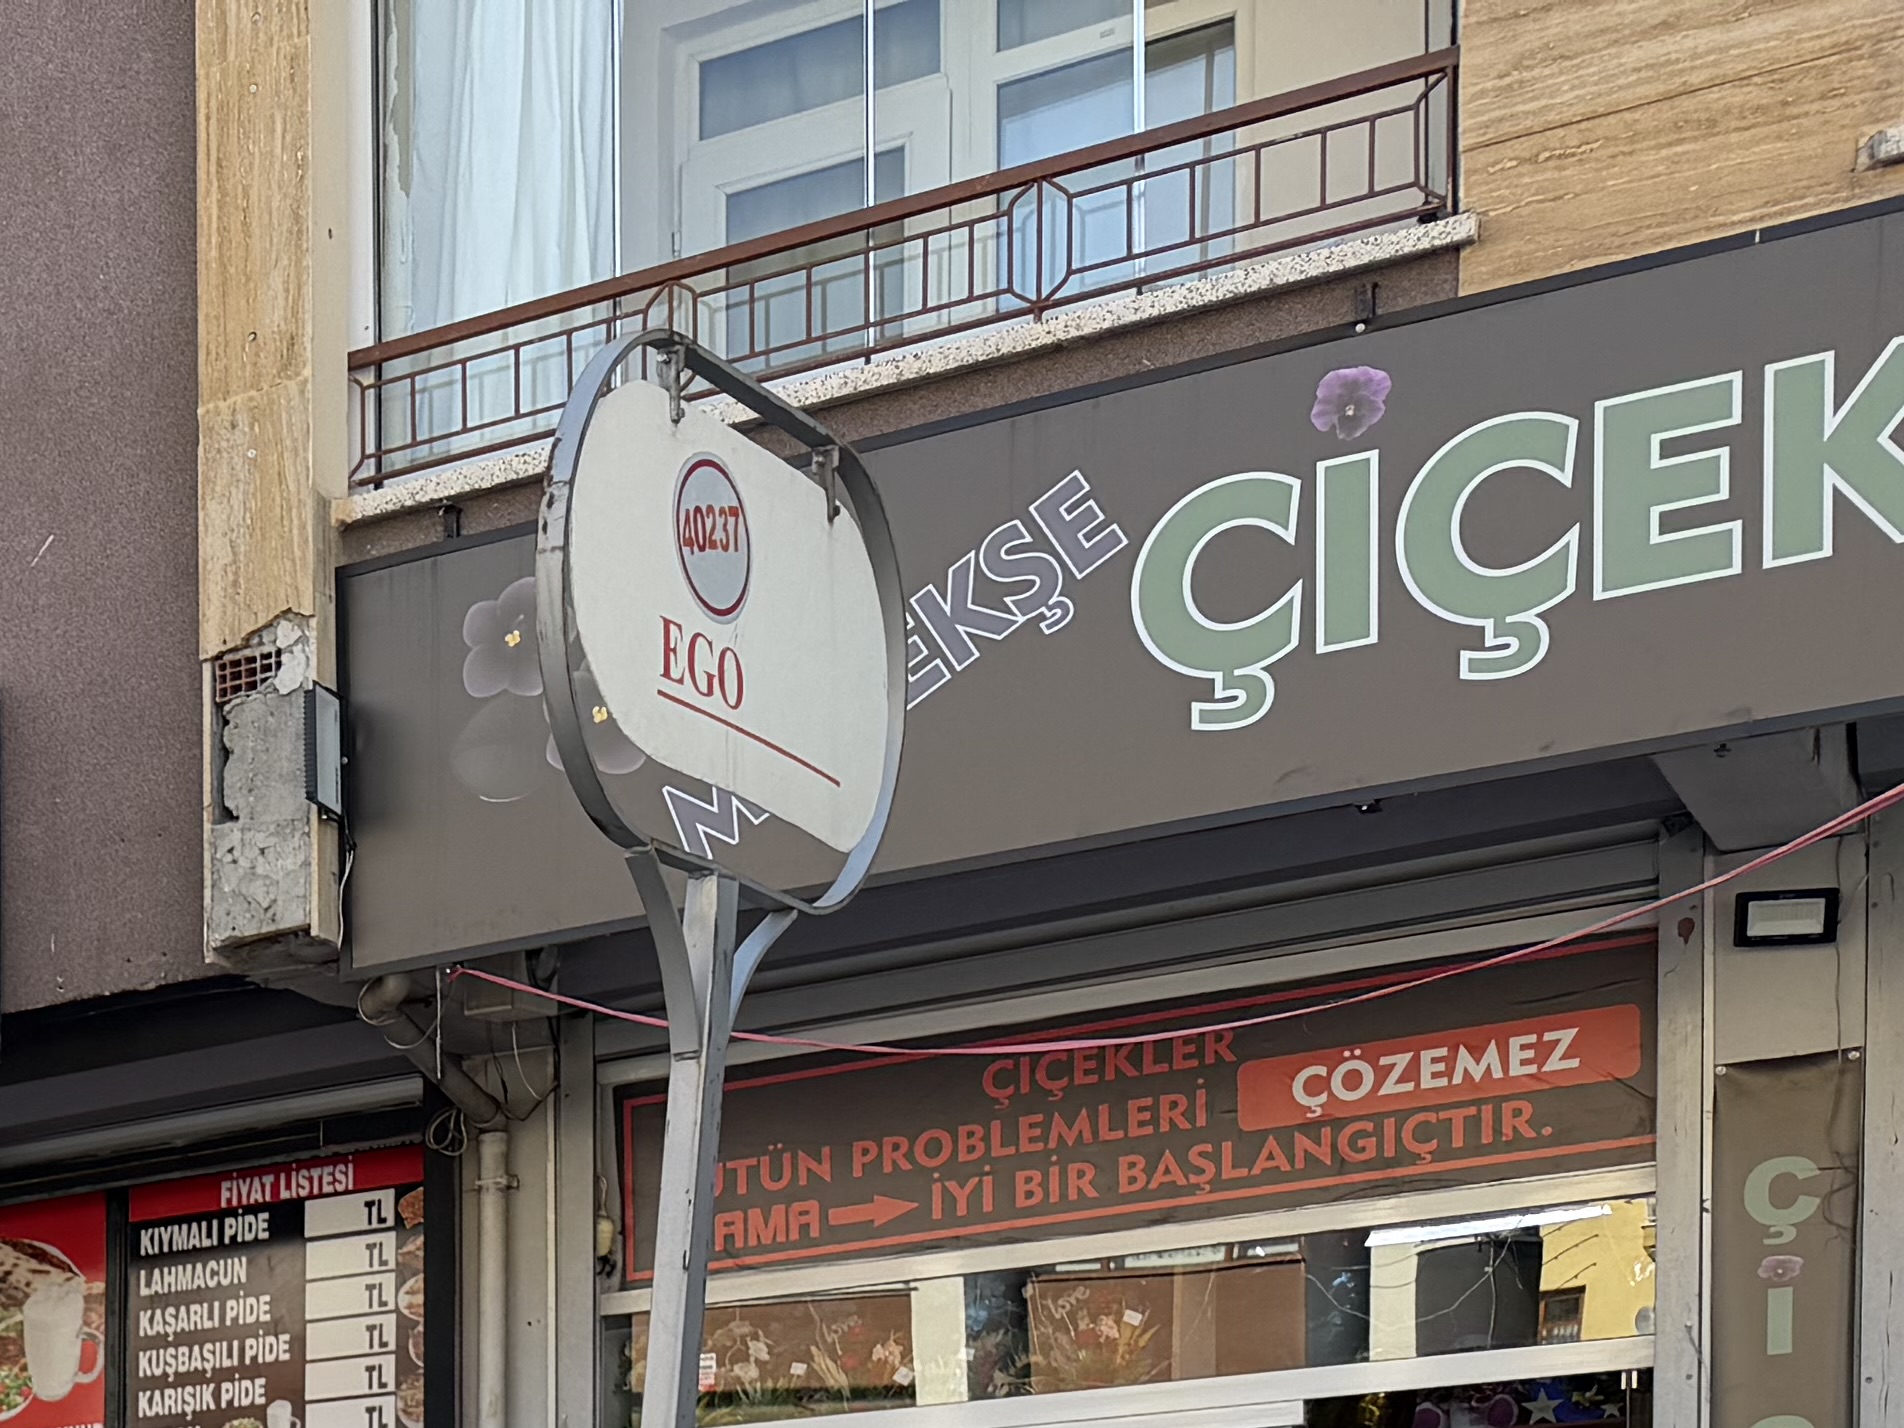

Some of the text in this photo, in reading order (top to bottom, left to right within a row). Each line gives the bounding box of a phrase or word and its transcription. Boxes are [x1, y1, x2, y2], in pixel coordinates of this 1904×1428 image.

[682, 504, 741, 556] 40237
[659, 614, 746, 711] EGO
[1291, 1027, 1580, 1117] ÇÖZEMEZ
[714, 1077, 1206, 1197] TÜN PROBLEMLERİ
[221, 1156, 354, 1208] FİYAT LİSTESİ
[714, 1101, 1553, 1251] AMA İYİ BİR BAŞLANGIÇTIR.
[140, 1198, 387, 1256] KIYMALI PİDE TL
[140, 1241, 388, 1296] LAHMACUN TL
[139, 1282, 388, 1341] KAŞARLI PİDE TL
[139, 1323, 388, 1382] KUŞBAŞILI PİDE TL
[138, 1364, 388, 1420] KARIŞIK PİDE TL
